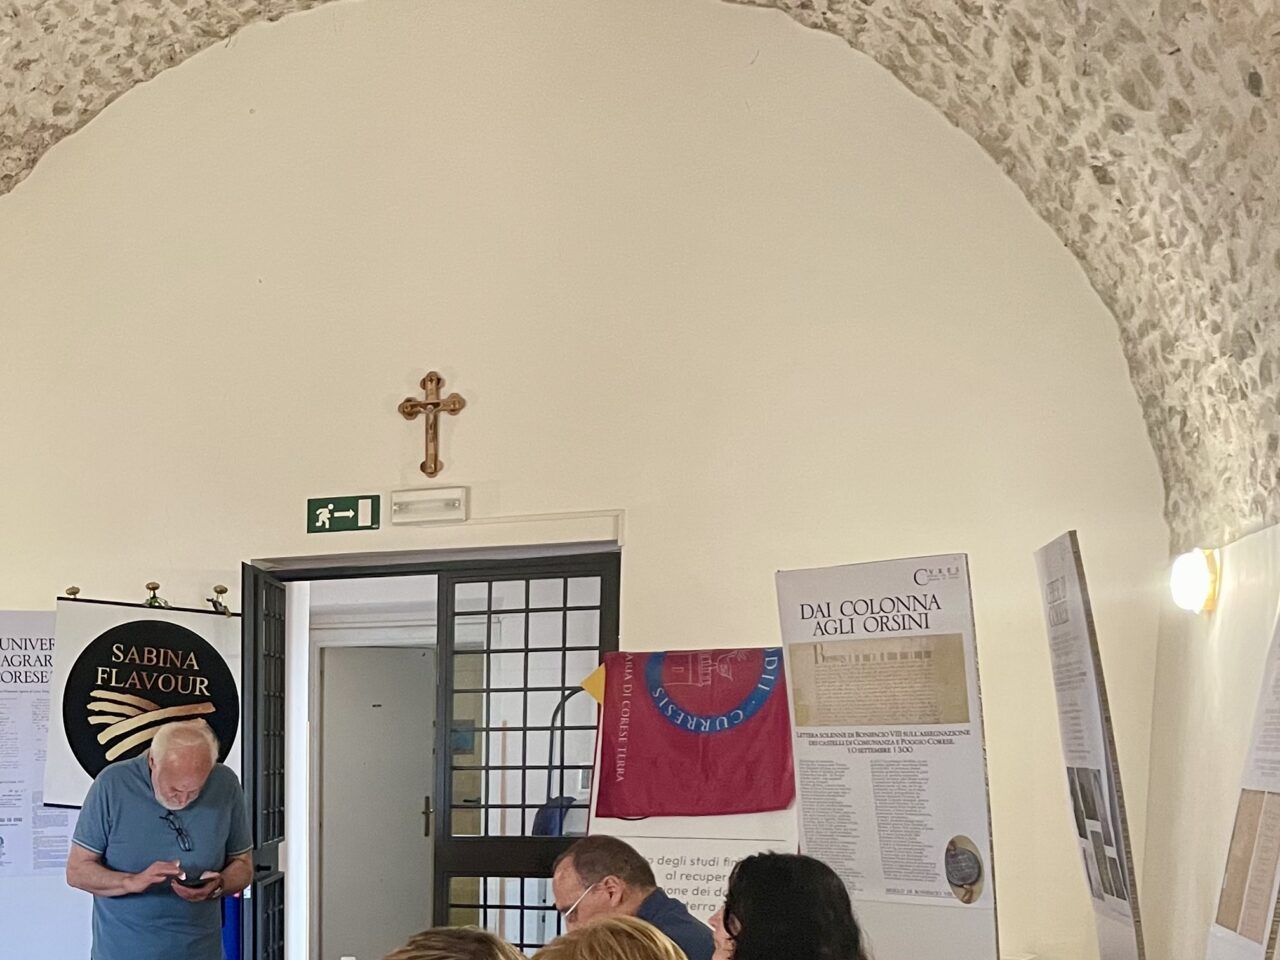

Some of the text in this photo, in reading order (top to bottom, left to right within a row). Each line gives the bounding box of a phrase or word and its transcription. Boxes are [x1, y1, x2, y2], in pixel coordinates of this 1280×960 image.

[800, 593, 942, 620] DAI COLONNA
[813, 612, 931, 637] AGLI ORSINI
[1, 654, 54, 667] AGRAR
[111, 643, 200, 670] SABINA
[758, 648, 778, 691] DII
[95, 666, 211, 696] FLAVOUR
[622, 684, 632, 697] DI
[617, 699, 632, 743] CORESE
[651, 686, 745, 732] CURRESIS
[657, 856, 687, 868] degli
[690, 856, 720, 867] studi
[665, 871, 677, 881] al
[692, 886, 710, 897] dei
